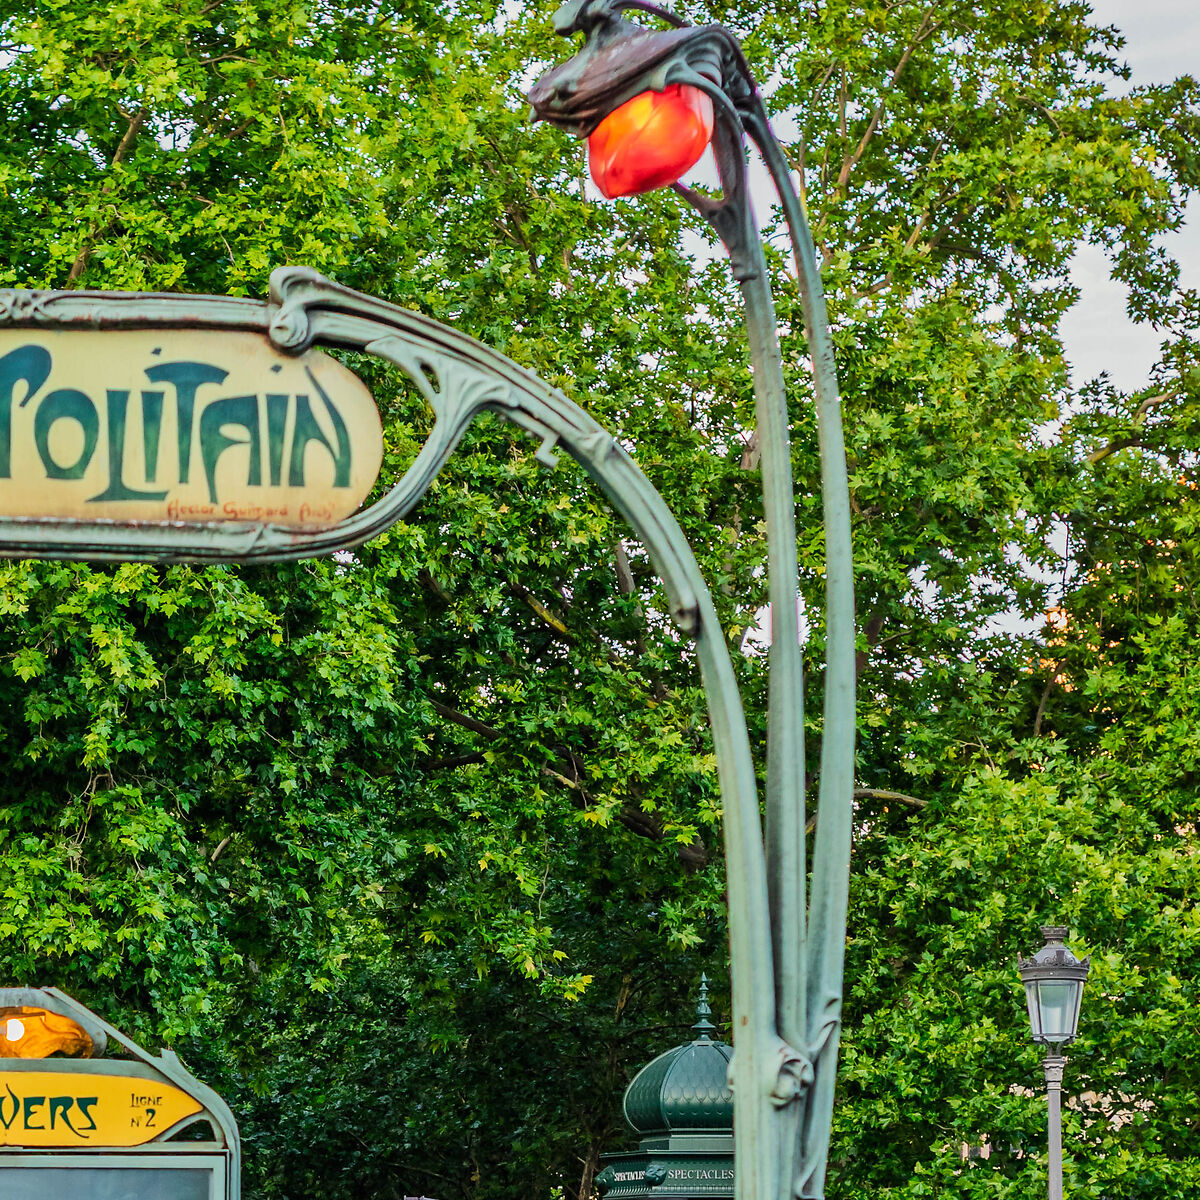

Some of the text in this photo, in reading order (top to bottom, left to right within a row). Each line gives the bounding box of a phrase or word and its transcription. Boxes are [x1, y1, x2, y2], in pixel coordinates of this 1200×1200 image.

[128, 1093, 163, 1108] LIGNE
[614, 1170, 645, 1181] SPECTACLES
[668, 1169, 734, 1179] SPECTACLES
